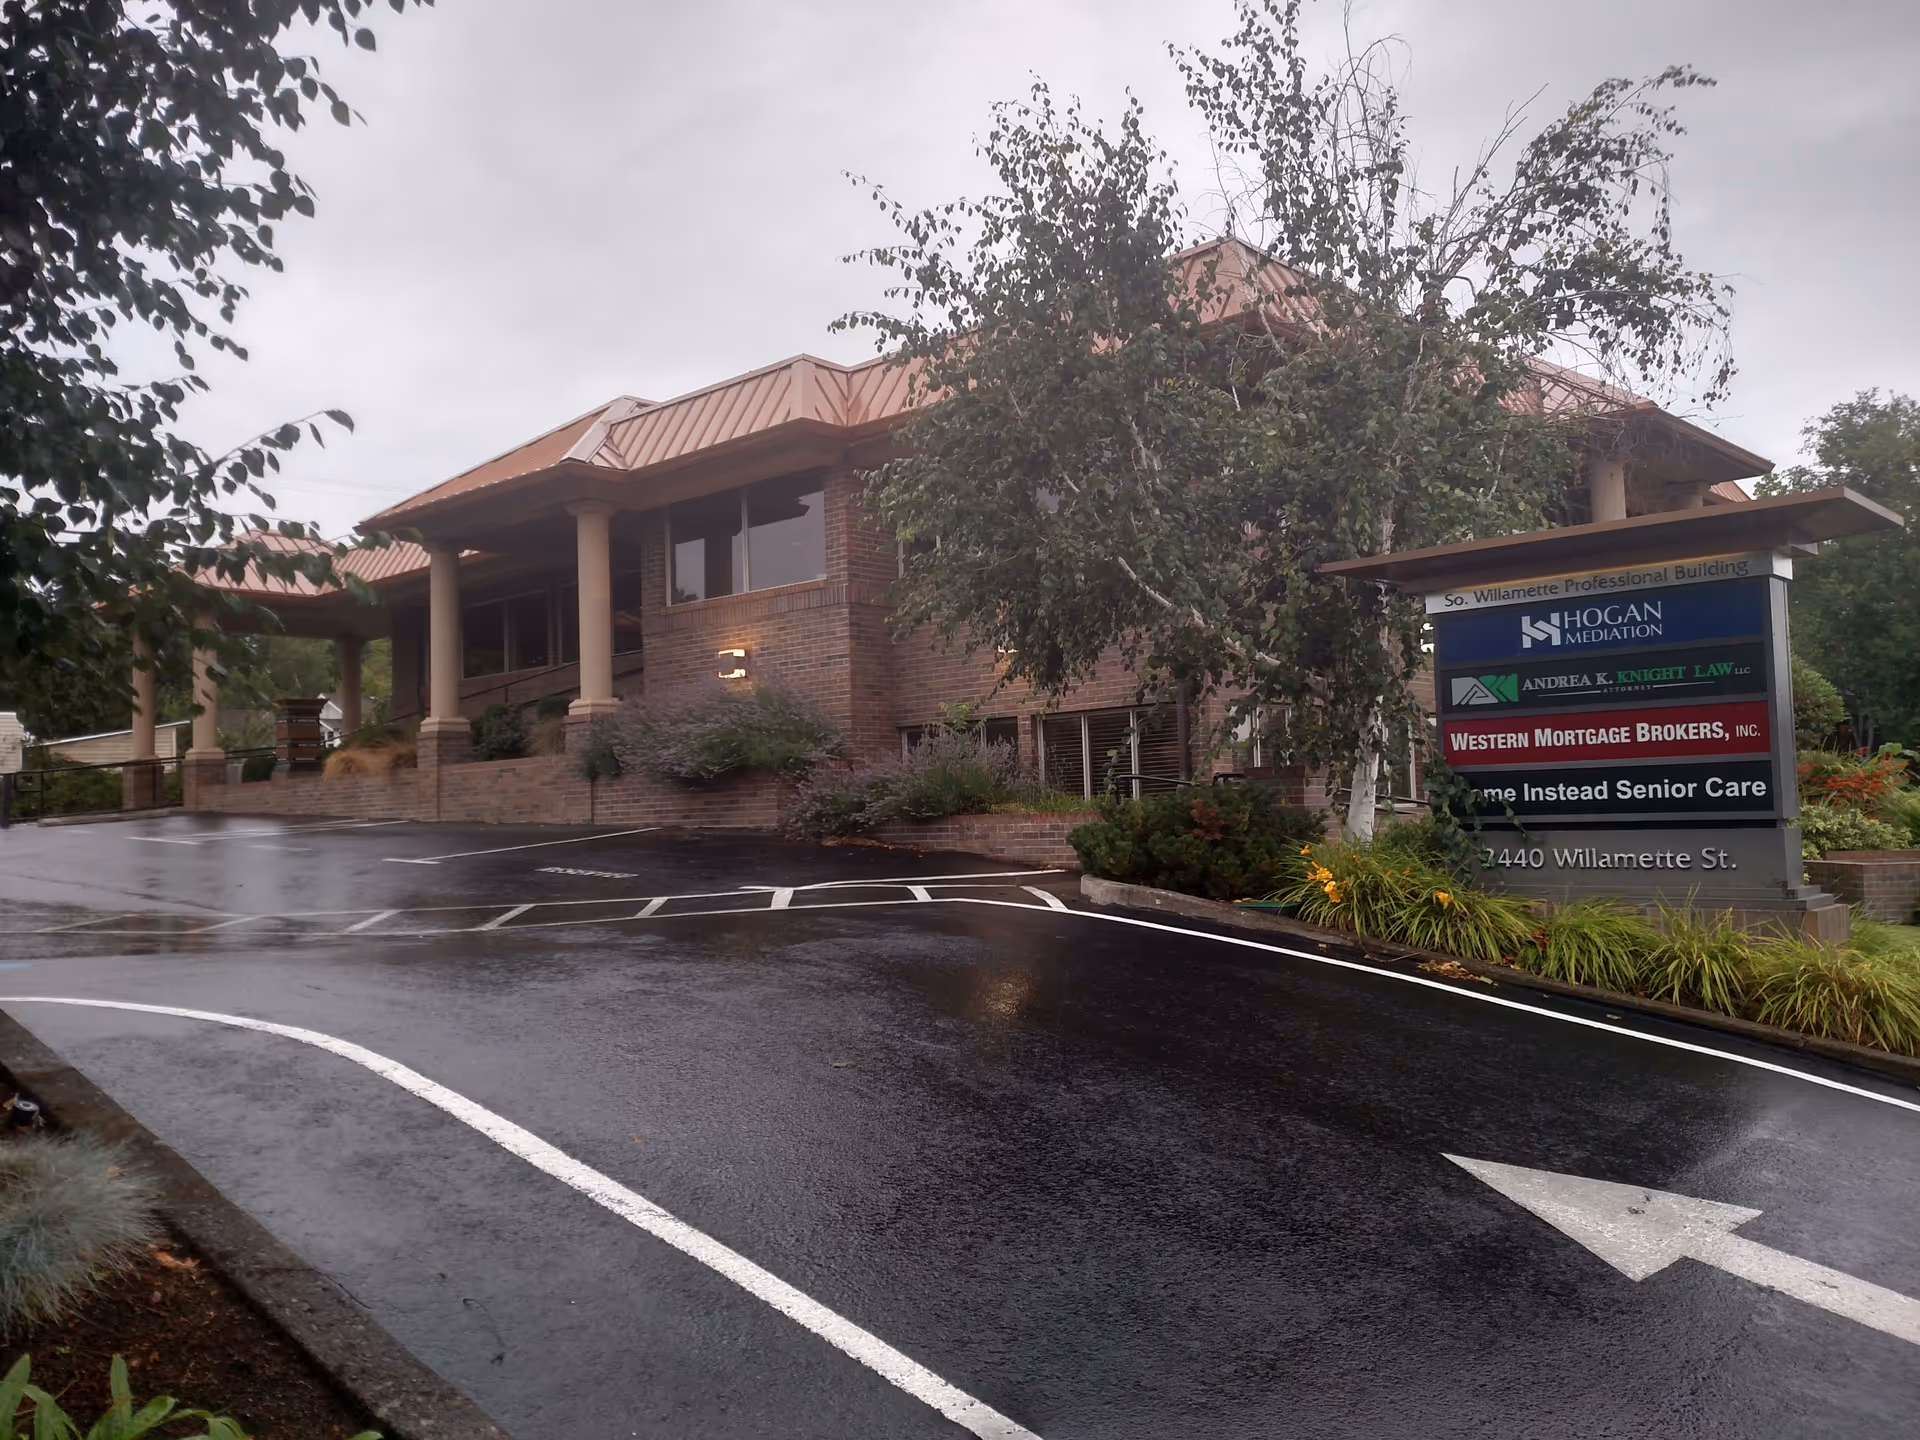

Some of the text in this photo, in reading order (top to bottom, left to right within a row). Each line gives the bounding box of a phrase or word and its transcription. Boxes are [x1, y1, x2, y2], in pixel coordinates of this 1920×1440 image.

[1444, 560, 1748, 608] So. Willamette Professional Building
[1564, 601, 1662, 629] HOGAN
[1565, 623, 1662, 644] MEDIATION
[1522, 662, 1750, 691] ANDREA K. KNIGHT LAW LLC
[1603, 684, 1651, 692] ATTORNEY
[1451, 721, 1761, 751] WESTERN MORTGAGE BROKERS, INC.
[1524, 781, 1608, 802] Instead
[1616, 779, 1697, 799] Senior
[1705, 778, 1766, 798] Care
[1552, 847, 1692, 870] Willamette
[1701, 848, 1738, 869] St.
